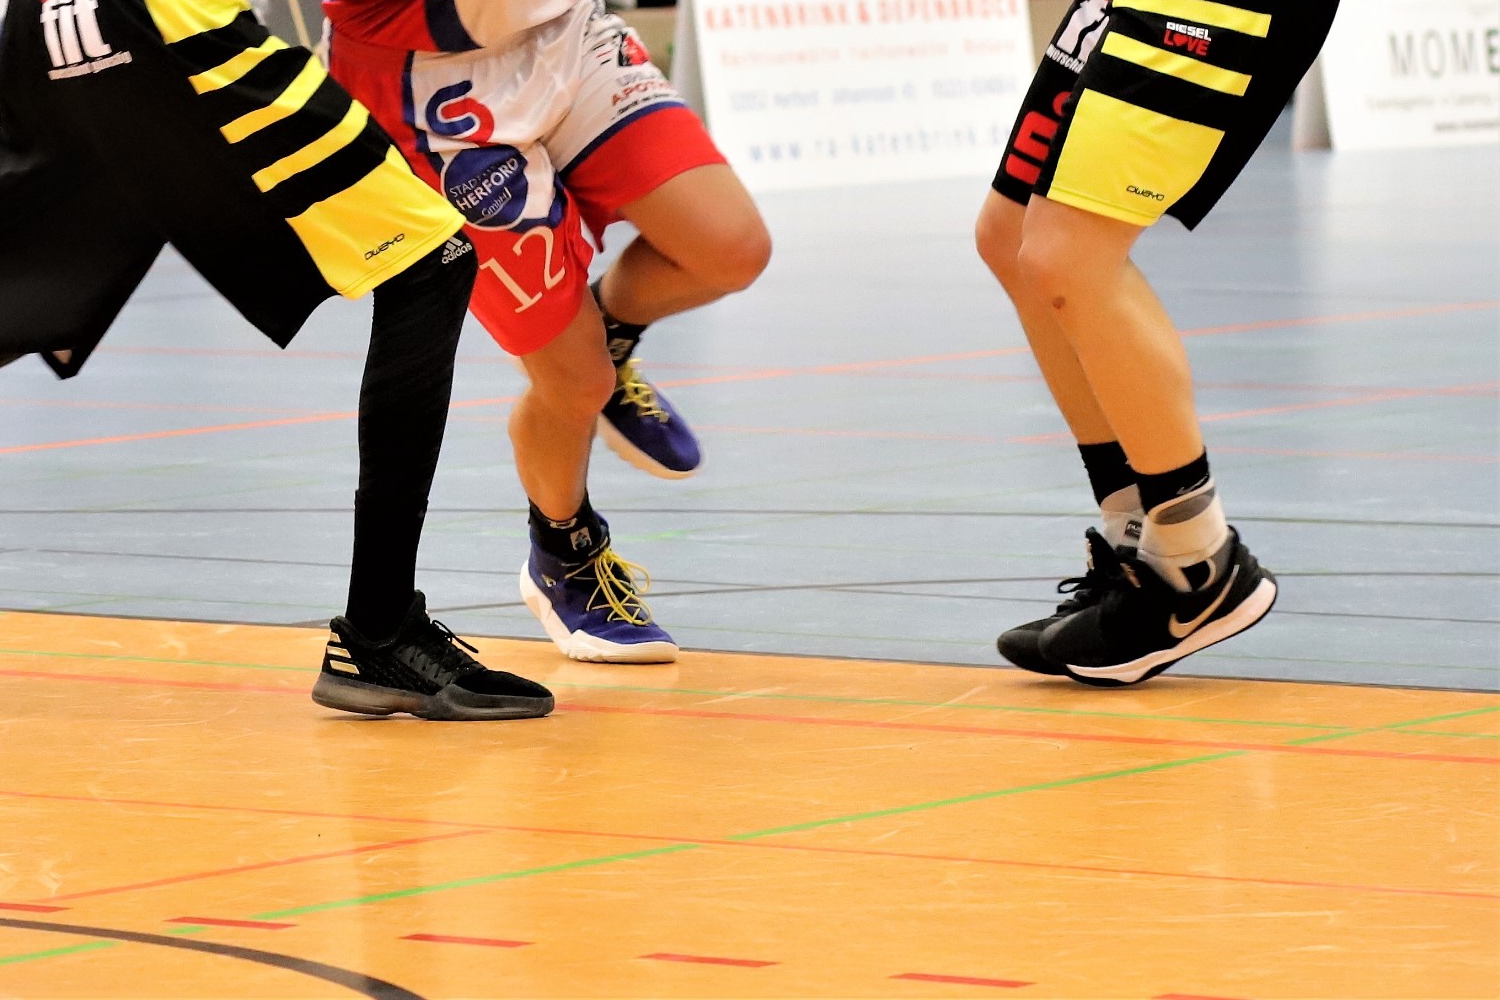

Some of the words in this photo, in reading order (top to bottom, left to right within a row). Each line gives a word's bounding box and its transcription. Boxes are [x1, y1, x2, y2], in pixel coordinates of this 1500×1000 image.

[1166, 21, 1212, 42] DIESEL
[455, 157, 519, 211] HERFORD
[441, 242, 473, 265] adidas
[478, 226, 566, 314] 12
